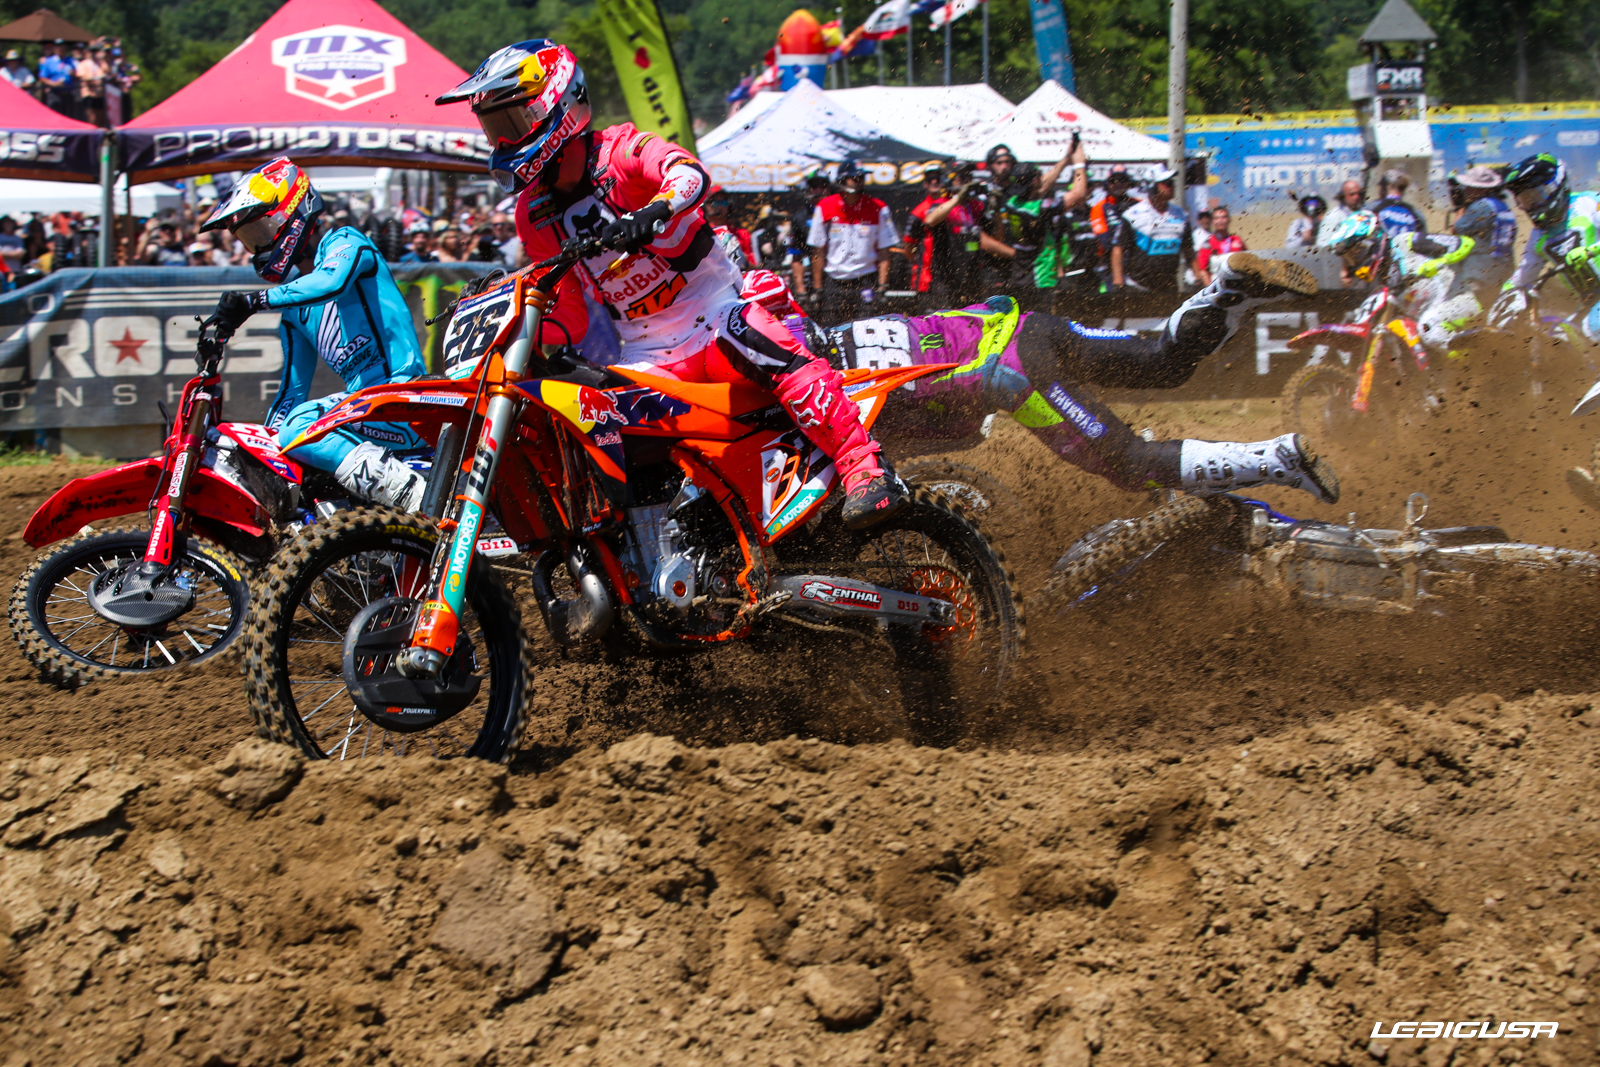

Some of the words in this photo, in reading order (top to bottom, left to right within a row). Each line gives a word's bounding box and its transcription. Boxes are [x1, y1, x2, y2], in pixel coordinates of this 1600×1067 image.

[280, 35, 395, 57] MX
[1376, 66, 1423, 85] FXR
[153, 126, 495, 162] PROMOTOCROS
[514, 140, 555, 184] Red
[546, 109, 578, 153] Bull
[270, 243, 294, 274] Red
[284, 220, 306, 248] Bull
[600, 278, 637, 305] Red
[633, 254, 672, 292] Bull
[624, 272, 688, 322] KTM
[443, 299, 512, 371] 26
[419, 395, 465, 406] PROGRESSIVE
[364, 426, 405, 444] HONDA
[594, 433, 609, 447] Red
[609, 431, 623, 445] Bull
[171, 453, 188, 485] SHOWA
[779, 492, 817, 527] MOTOREX
[147, 510, 167, 556] DUNLOP
[384, 524, 440, 545] DUNLO
[450, 511, 479, 574] MOTOREX
[801, 580, 881, 604] RENTHAL
[402, 707, 437, 715] POWERPARTS
